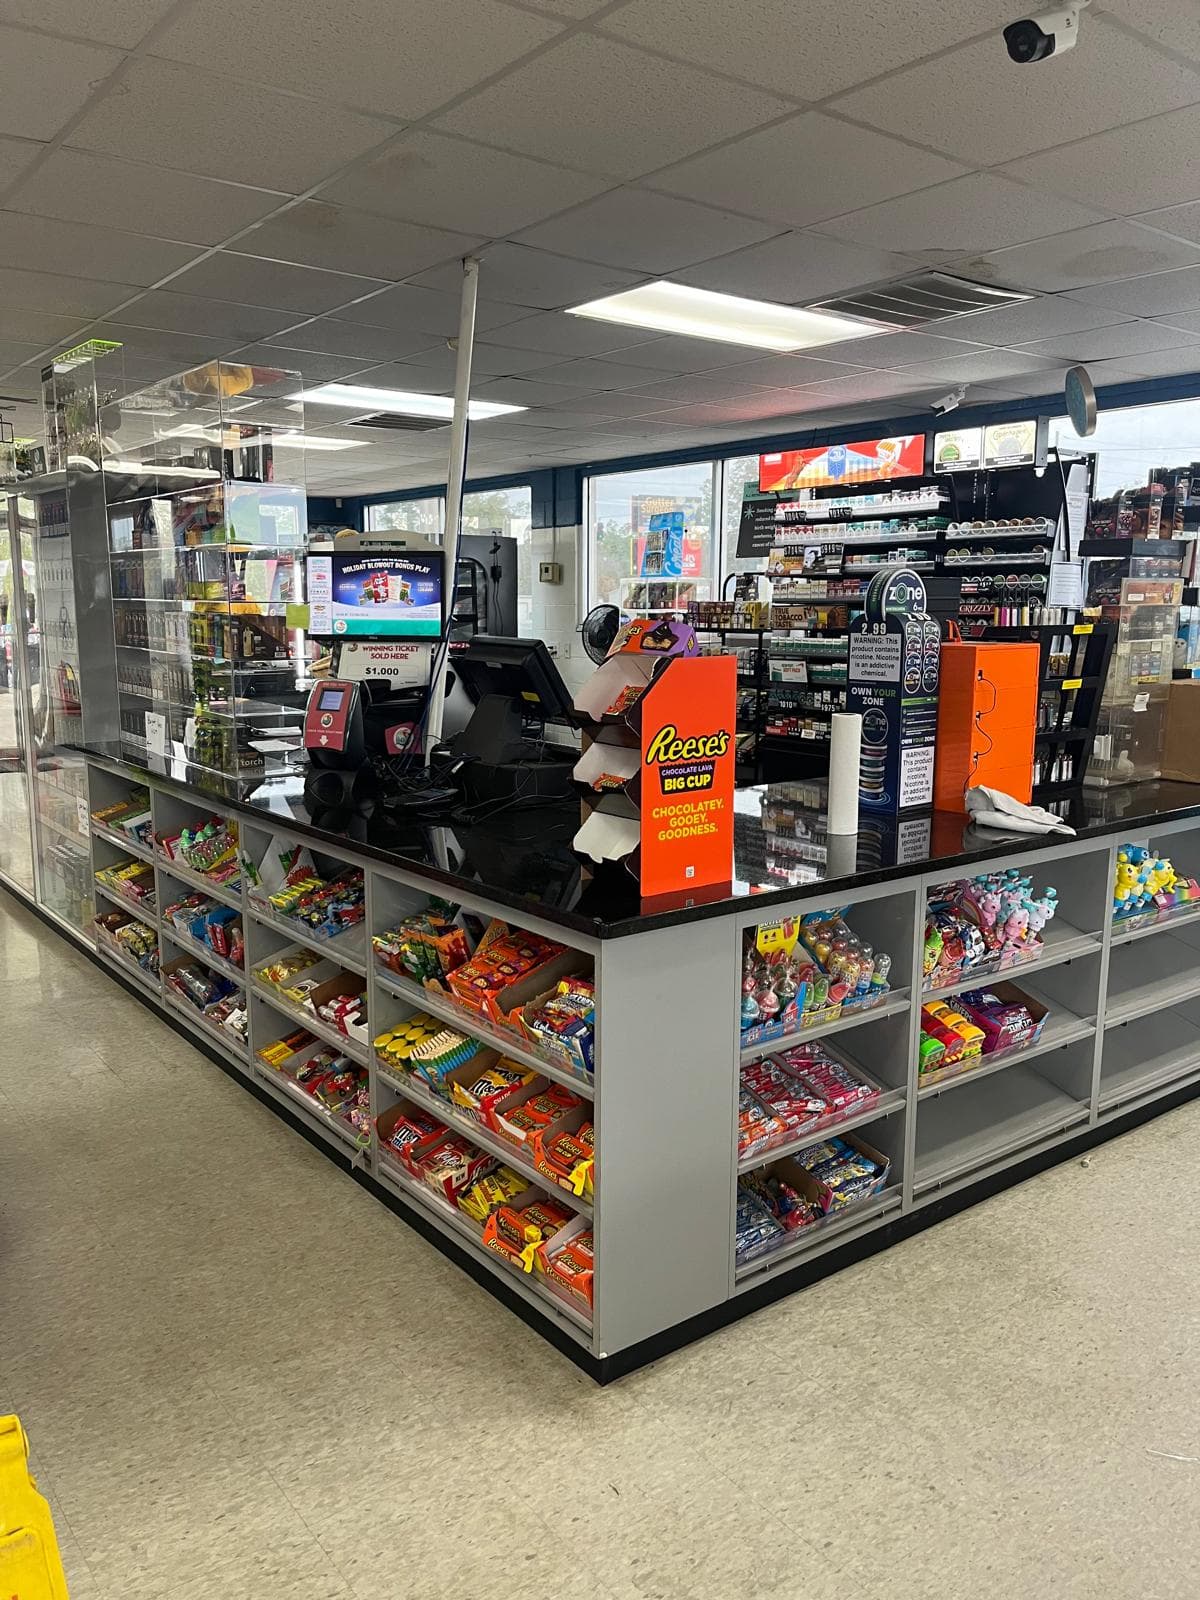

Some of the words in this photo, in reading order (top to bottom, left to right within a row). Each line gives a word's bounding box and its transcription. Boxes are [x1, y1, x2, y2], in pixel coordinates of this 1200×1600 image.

[341, 562, 366, 574] HOLIDAY
[367, 561, 395, 569] BLOWOUT
[395, 562, 414, 570] BONUS
[414, 564, 431, 574] PLAY
[959, 604, 993, 612] GRIZZLY
[362, 645, 394, 653] WINNING
[395, 645, 419, 653] TICKET
[852, 646, 874, 654] product
[869, 661, 895, 669] addictive
[861, 669, 887, 677] chemical.
[851, 687, 872, 696] OWN
[873, 688, 896, 697] YOUR
[862, 696, 884, 706] ZONE
[647, 726, 730, 764] Reese's
[241, 758, 263, 767] torch
[914, 758, 932, 766] product
[661, 766, 697, 776] CHOCOLATE
[697, 764, 713, 773] LAVA
[907, 765, 928, 773] contains
[664, 778, 686, 791] BIG
[686, 773, 711, 788] CUP
[904, 780, 925, 788] Nicotine
[909, 786, 931, 795] addictive
[652, 798, 724, 819] CHOCOLATEY.
[669, 813, 708, 828] GOOEY.
[658, 823, 719, 841] GOODNESS.
